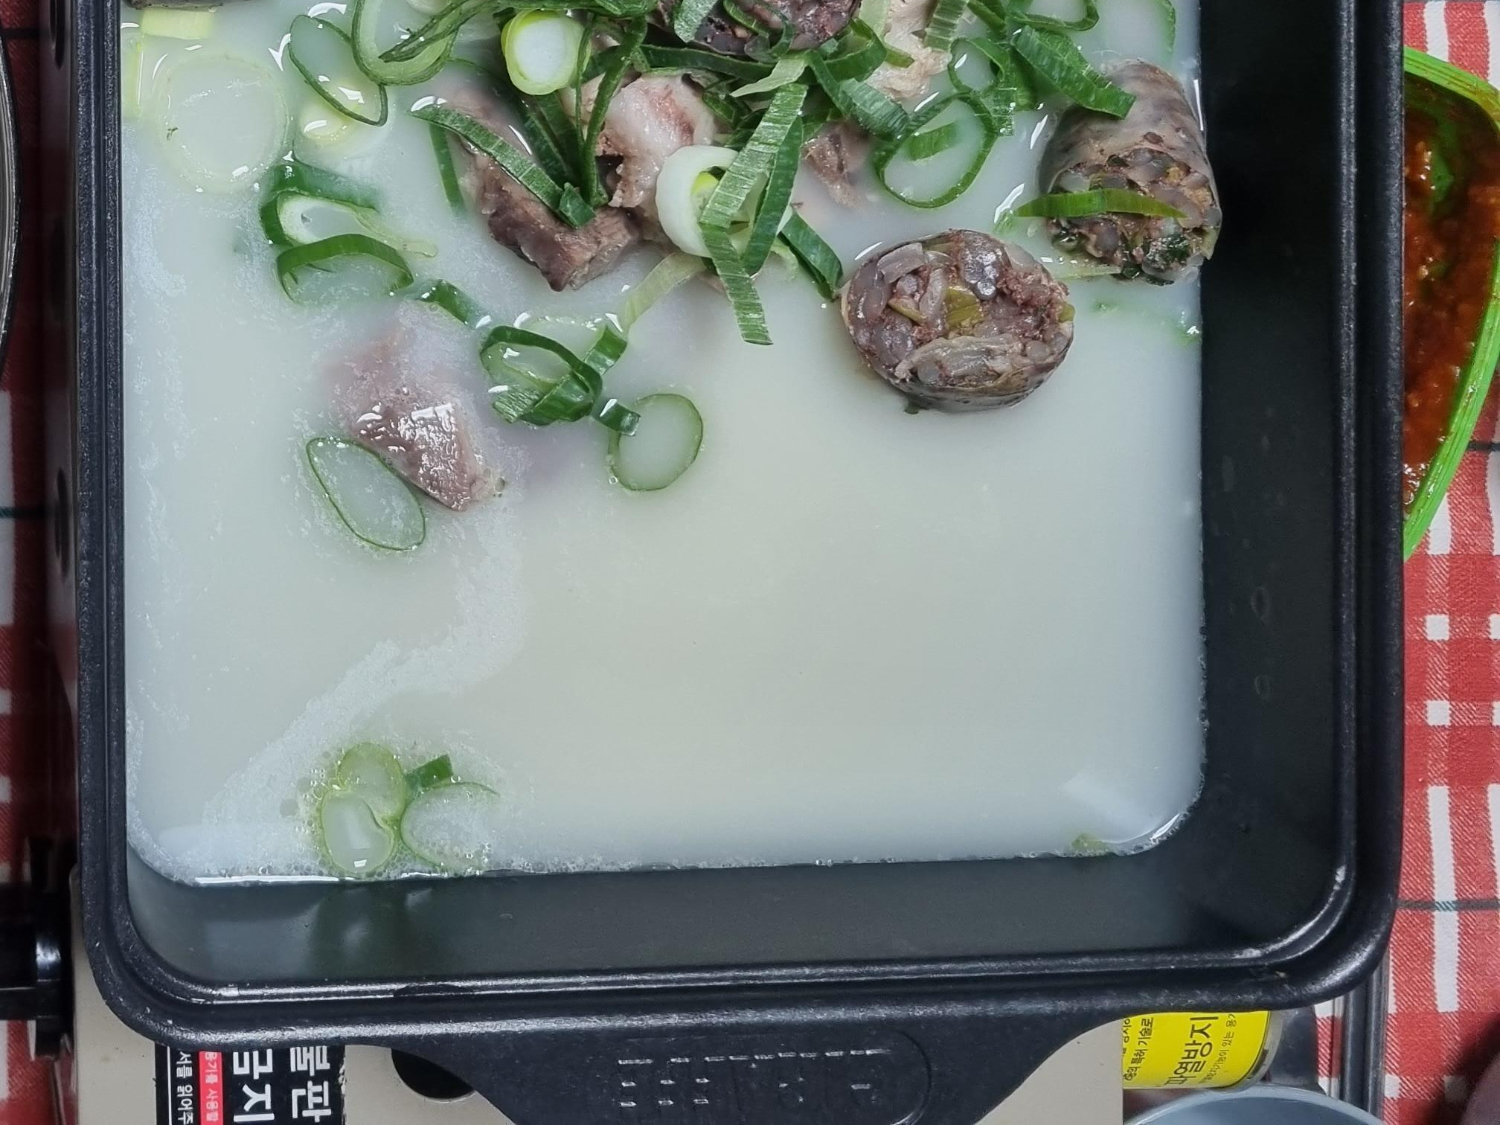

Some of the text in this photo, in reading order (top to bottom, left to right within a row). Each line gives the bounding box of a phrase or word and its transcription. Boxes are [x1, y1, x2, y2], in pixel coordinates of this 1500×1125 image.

[1138, 1017, 1154, 1046] 기술로
[1164, 1015, 1219, 1086] 파열방지
[175, 1051, 192, 1079] 서를
[232, 1048, 275, 1123] 금지
